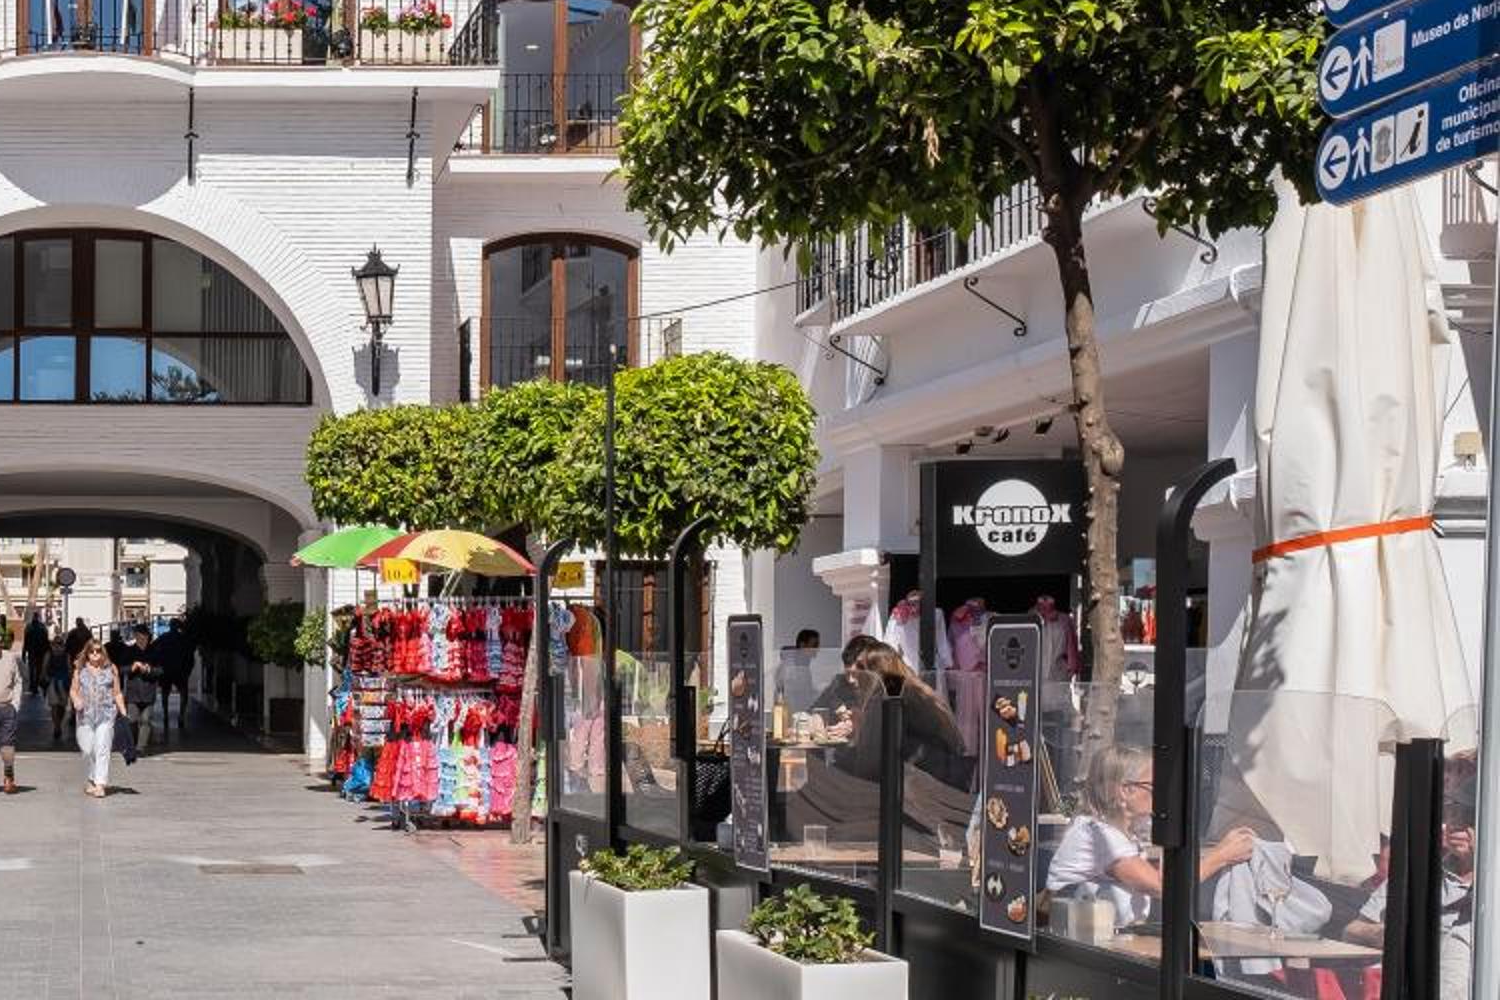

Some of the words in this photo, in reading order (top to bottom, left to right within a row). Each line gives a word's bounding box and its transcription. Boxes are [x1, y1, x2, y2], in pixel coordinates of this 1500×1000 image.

[1411, 21, 1451, 48] Museo
[1453, 11, 1469, 31] de
[1435, 136, 1451, 153] de
[1453, 120, 1500, 147] turismo
[987, 527, 1037, 543] café
